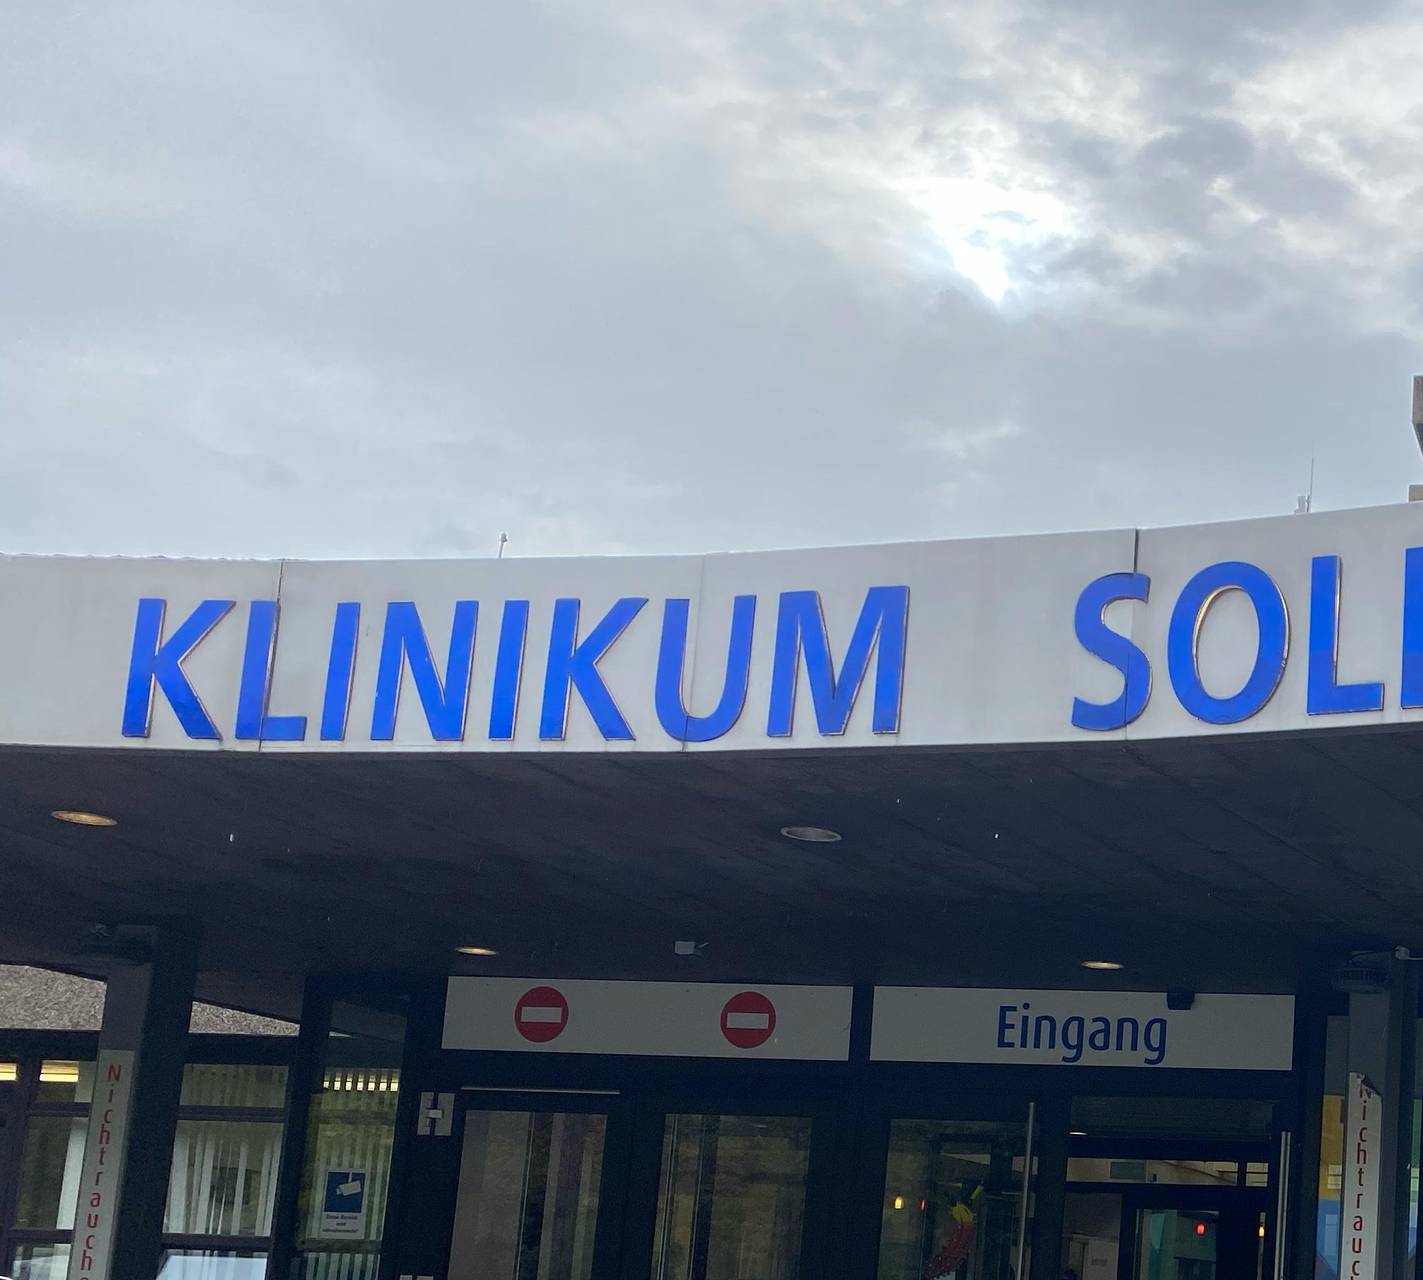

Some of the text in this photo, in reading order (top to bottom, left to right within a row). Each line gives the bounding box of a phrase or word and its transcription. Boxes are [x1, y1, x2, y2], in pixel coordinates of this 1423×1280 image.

[121, 585, 910, 743] KLINIKUM
[997, 1003, 1167, 1065] Eingang
[79, 1063, 122, 1280] Nichtrauch
